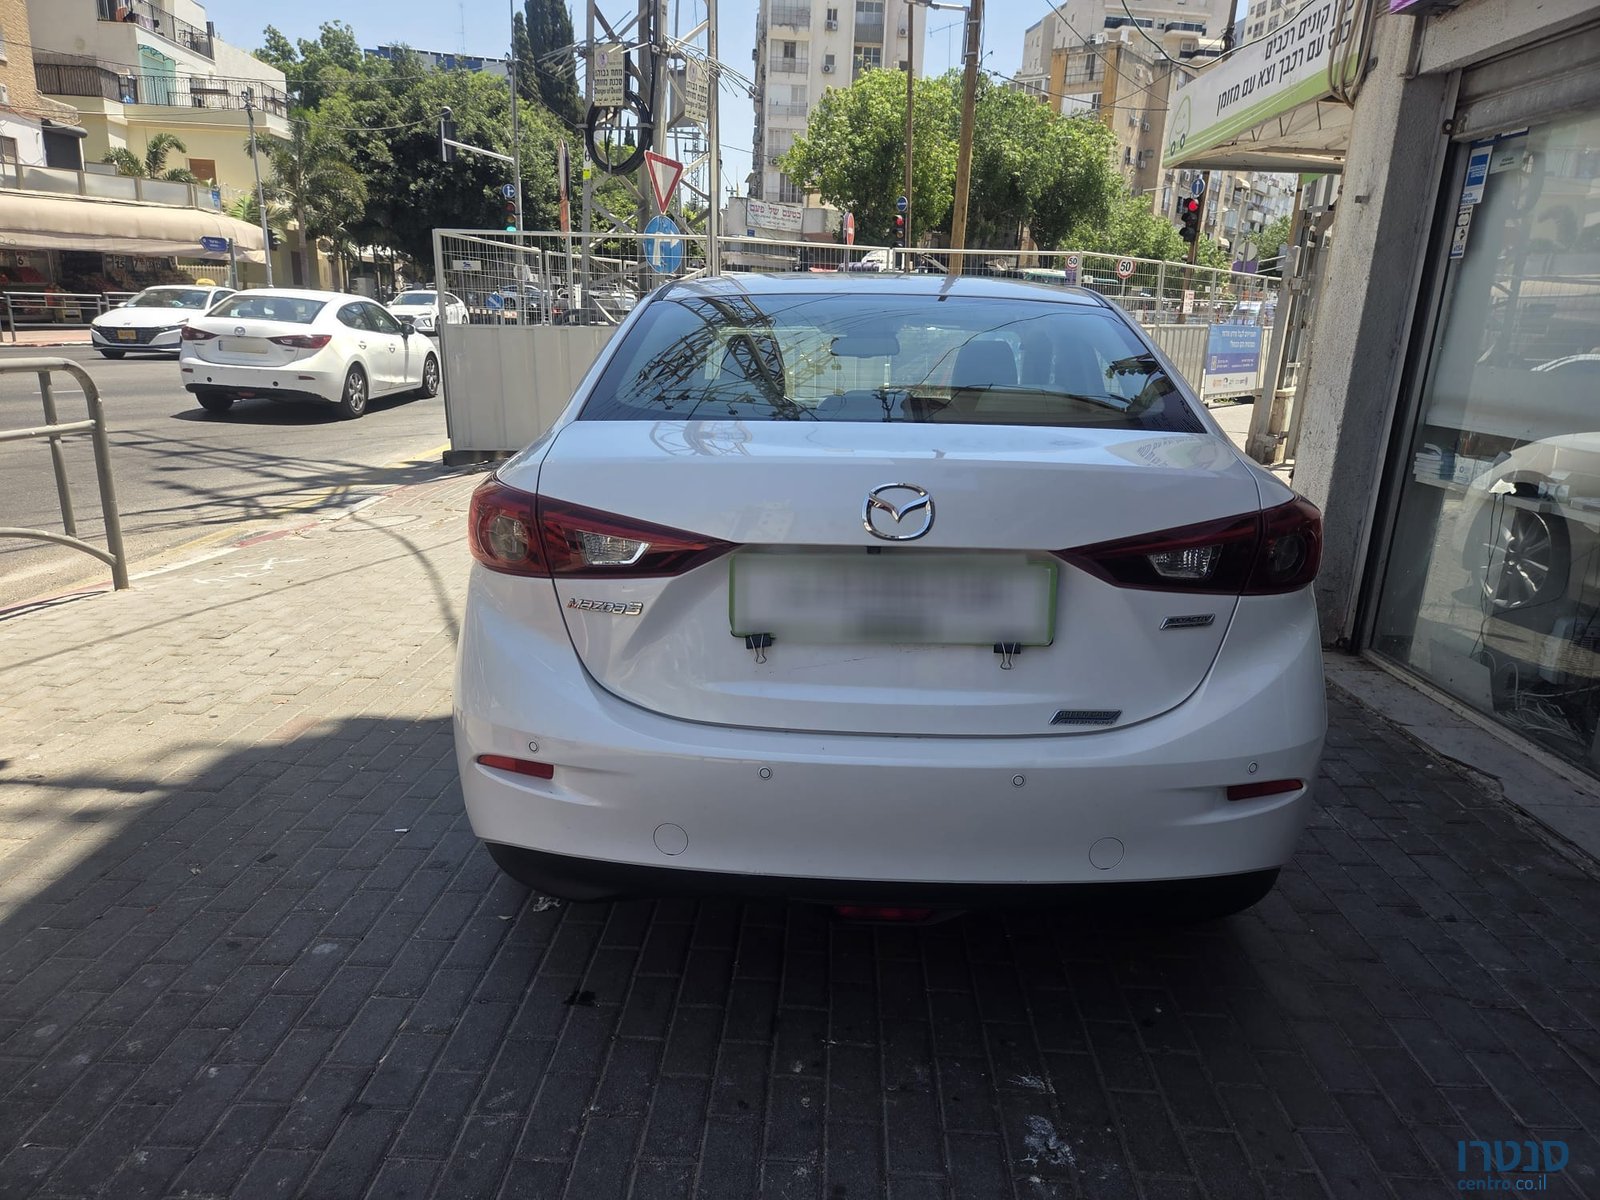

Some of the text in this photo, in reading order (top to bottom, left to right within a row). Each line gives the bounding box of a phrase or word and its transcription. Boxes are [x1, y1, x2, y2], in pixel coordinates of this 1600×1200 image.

[1297, 4, 1331, 41] קונים
[1264, 26, 1295, 61] רכבים
[1306, 33, 1325, 64] עם
[1257, 63, 1276, 90] וצא
[1278, 47, 1304, 84] רכבך
[1216, 84, 1241, 116] מזומן
[1242, 73, 1256, 98] עם
[749, 203, 765, 213] פעם
[767, 204, 780, 216] של
[1119, 261, 1131, 272] 50
